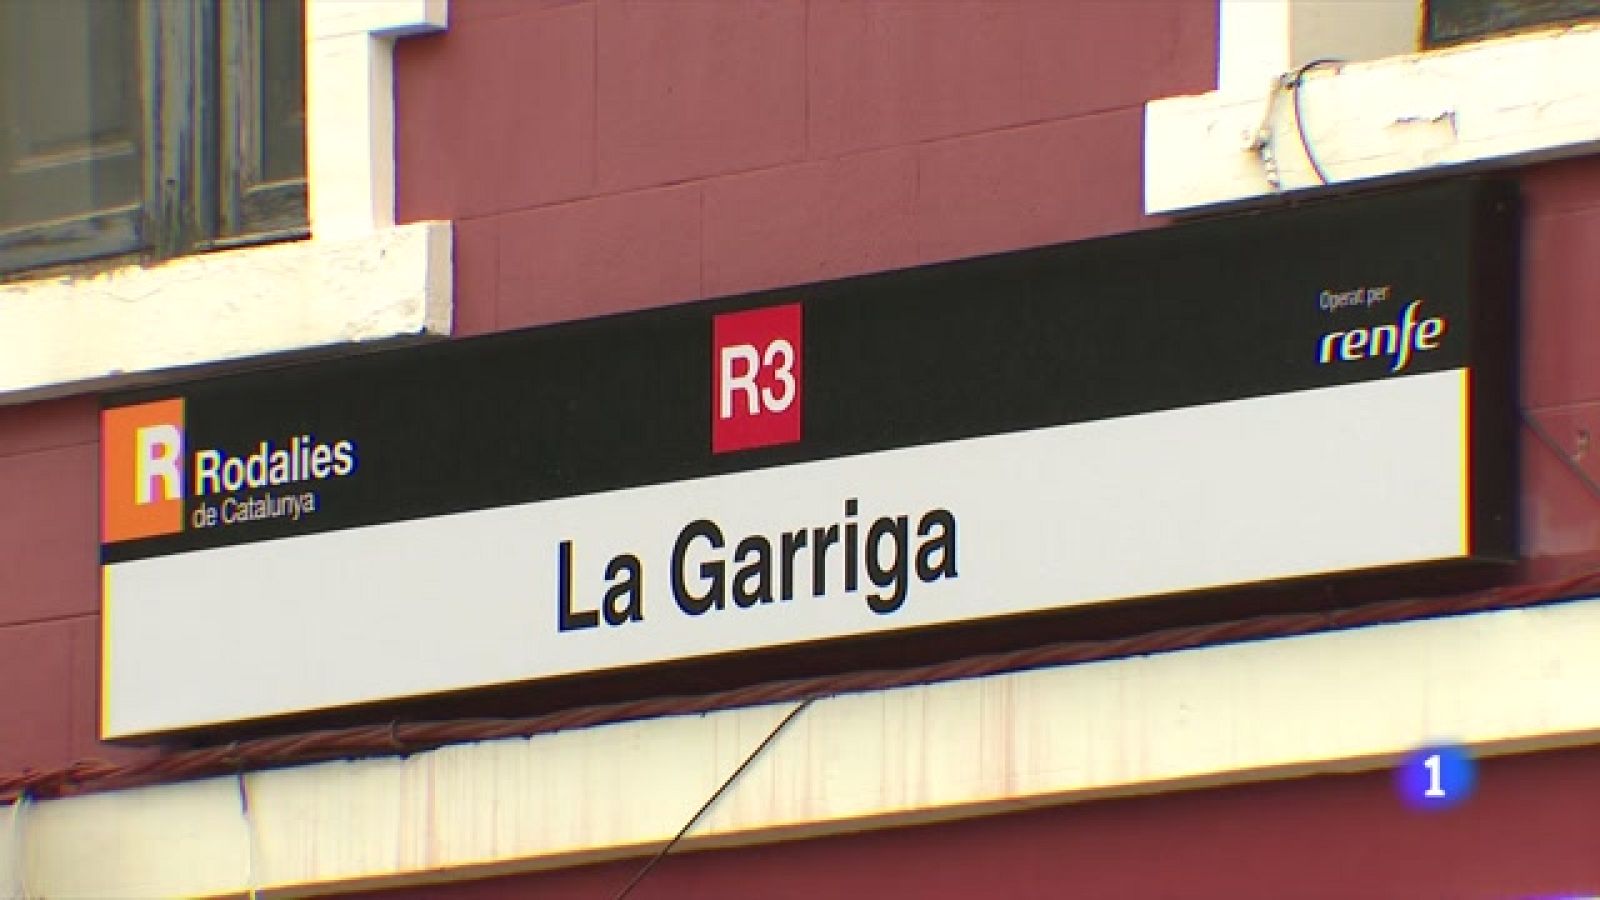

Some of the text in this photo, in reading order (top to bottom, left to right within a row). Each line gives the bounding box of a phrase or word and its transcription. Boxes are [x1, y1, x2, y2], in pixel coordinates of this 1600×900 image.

[1319, 285, 1391, 312] Operat per
[1317, 299, 1447, 372] renfe
[719, 338, 797, 419] R3
[134, 424, 184, 505] R
[194, 434, 355, 496] Rodalies
[192, 491, 319, 529] de Catalunya
[557, 497, 959, 633] La Garriga
